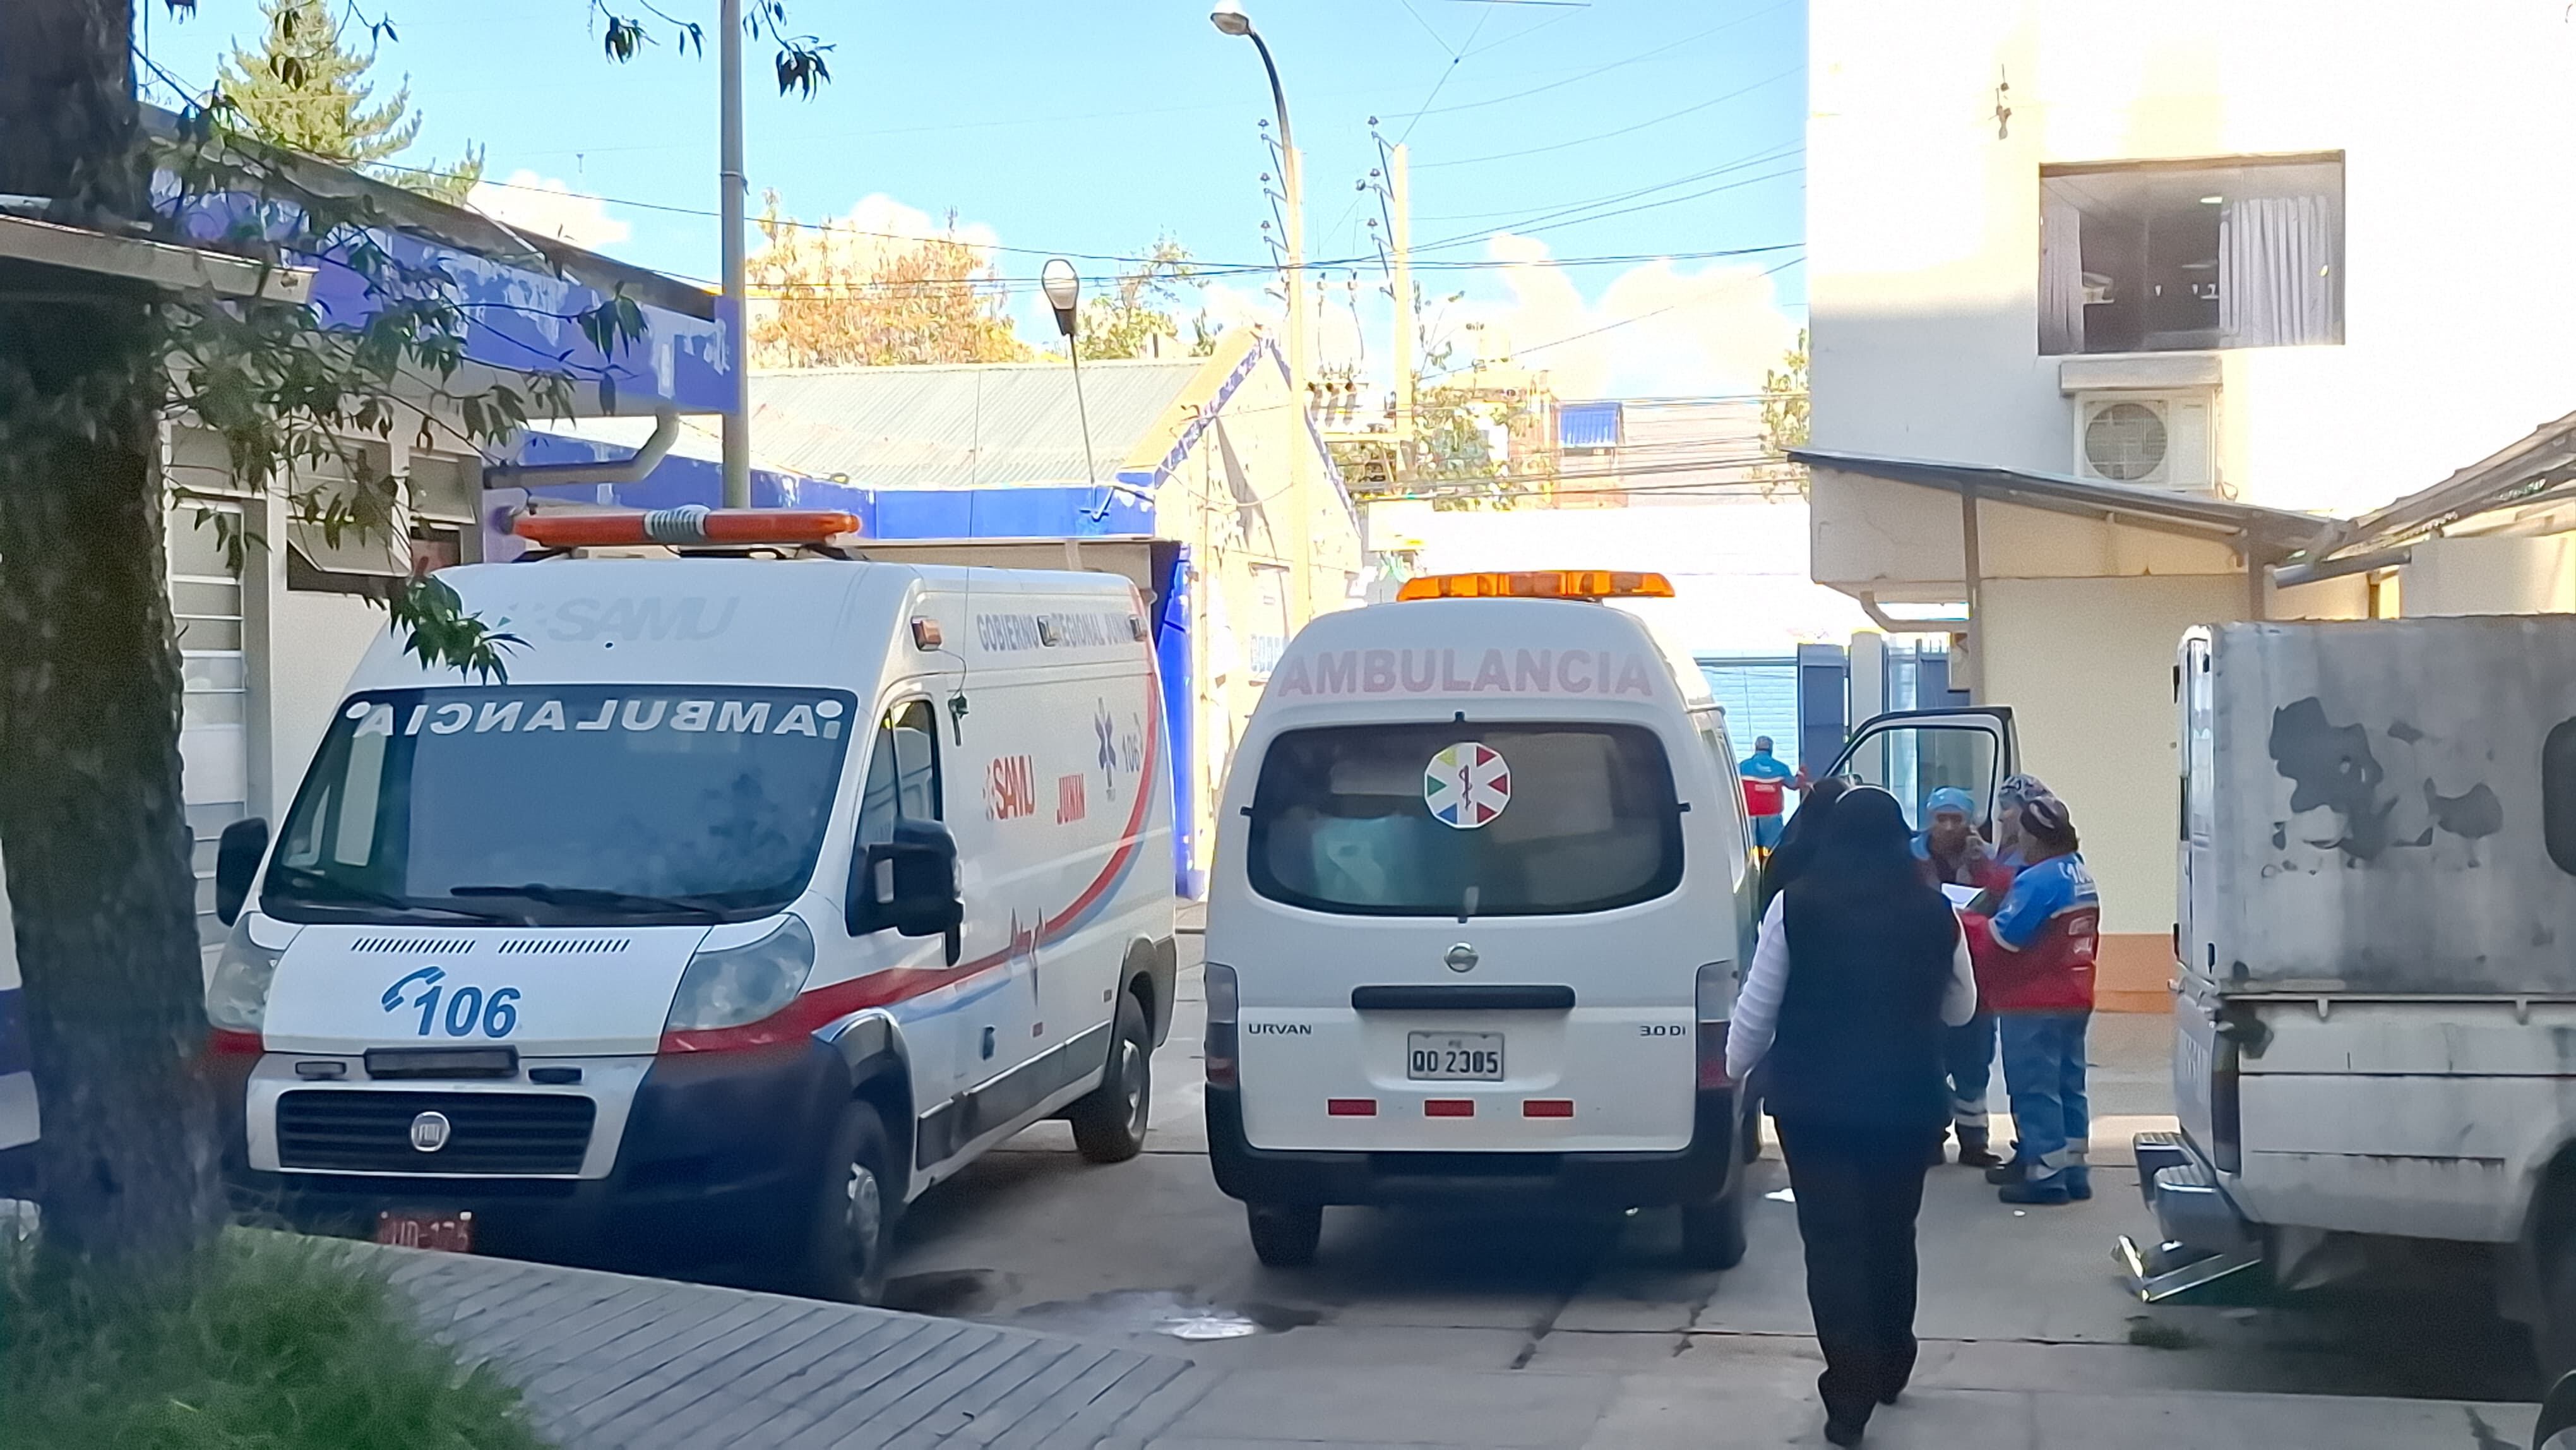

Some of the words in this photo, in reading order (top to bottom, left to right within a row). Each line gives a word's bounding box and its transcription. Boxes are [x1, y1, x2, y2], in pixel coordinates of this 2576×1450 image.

[547, 596, 740, 642] SAMU
[977, 613, 1039, 652] GOBIERNO
[1278, 647, 1652, 697] AMBULANCIA
[1122, 733, 1141, 774] 106
[414, 985, 522, 1038] 106
[1248, 1023, 1312, 1035] URVAN
